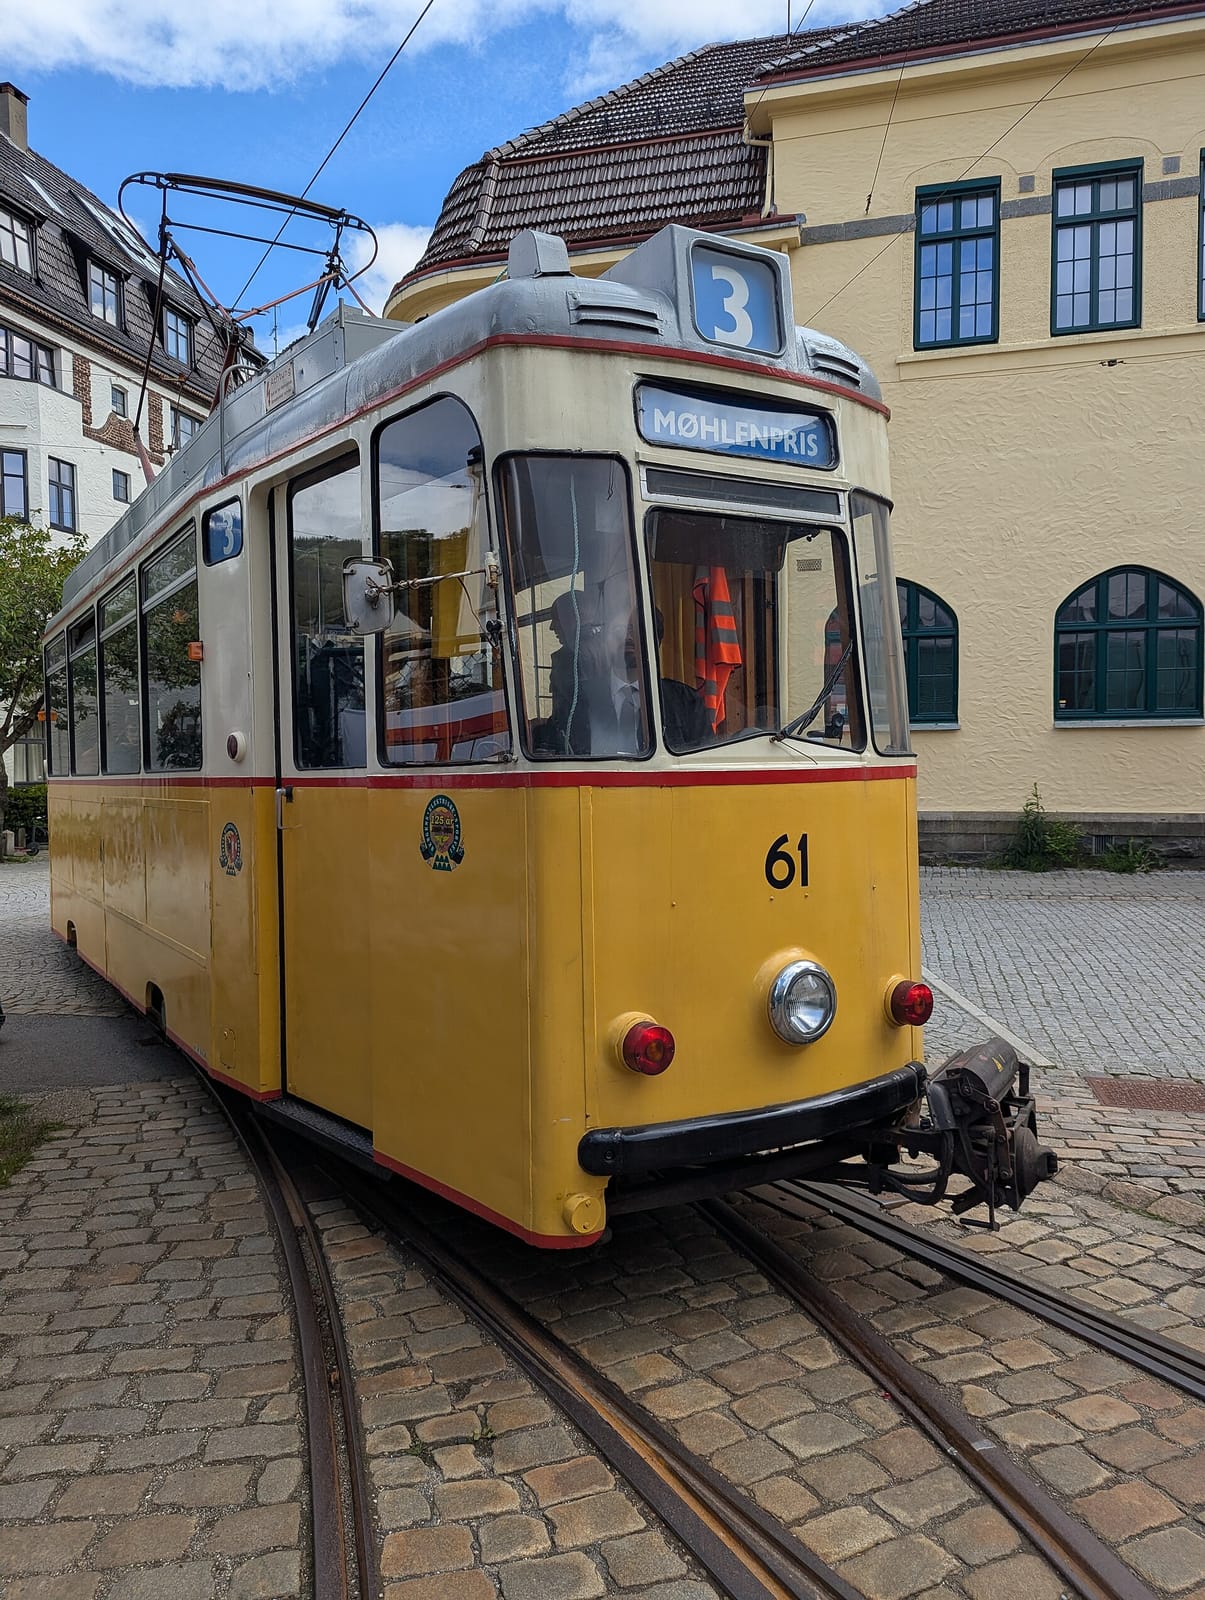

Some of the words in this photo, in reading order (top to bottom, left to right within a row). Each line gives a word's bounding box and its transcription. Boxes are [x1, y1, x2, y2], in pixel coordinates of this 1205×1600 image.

[711, 265, 753, 348] 3
[653, 408, 818, 457] MØHLENPRIS
[222, 511, 234, 555] 3
[431, 815, 444, 825] 125
[765, 833, 808, 890] 61
